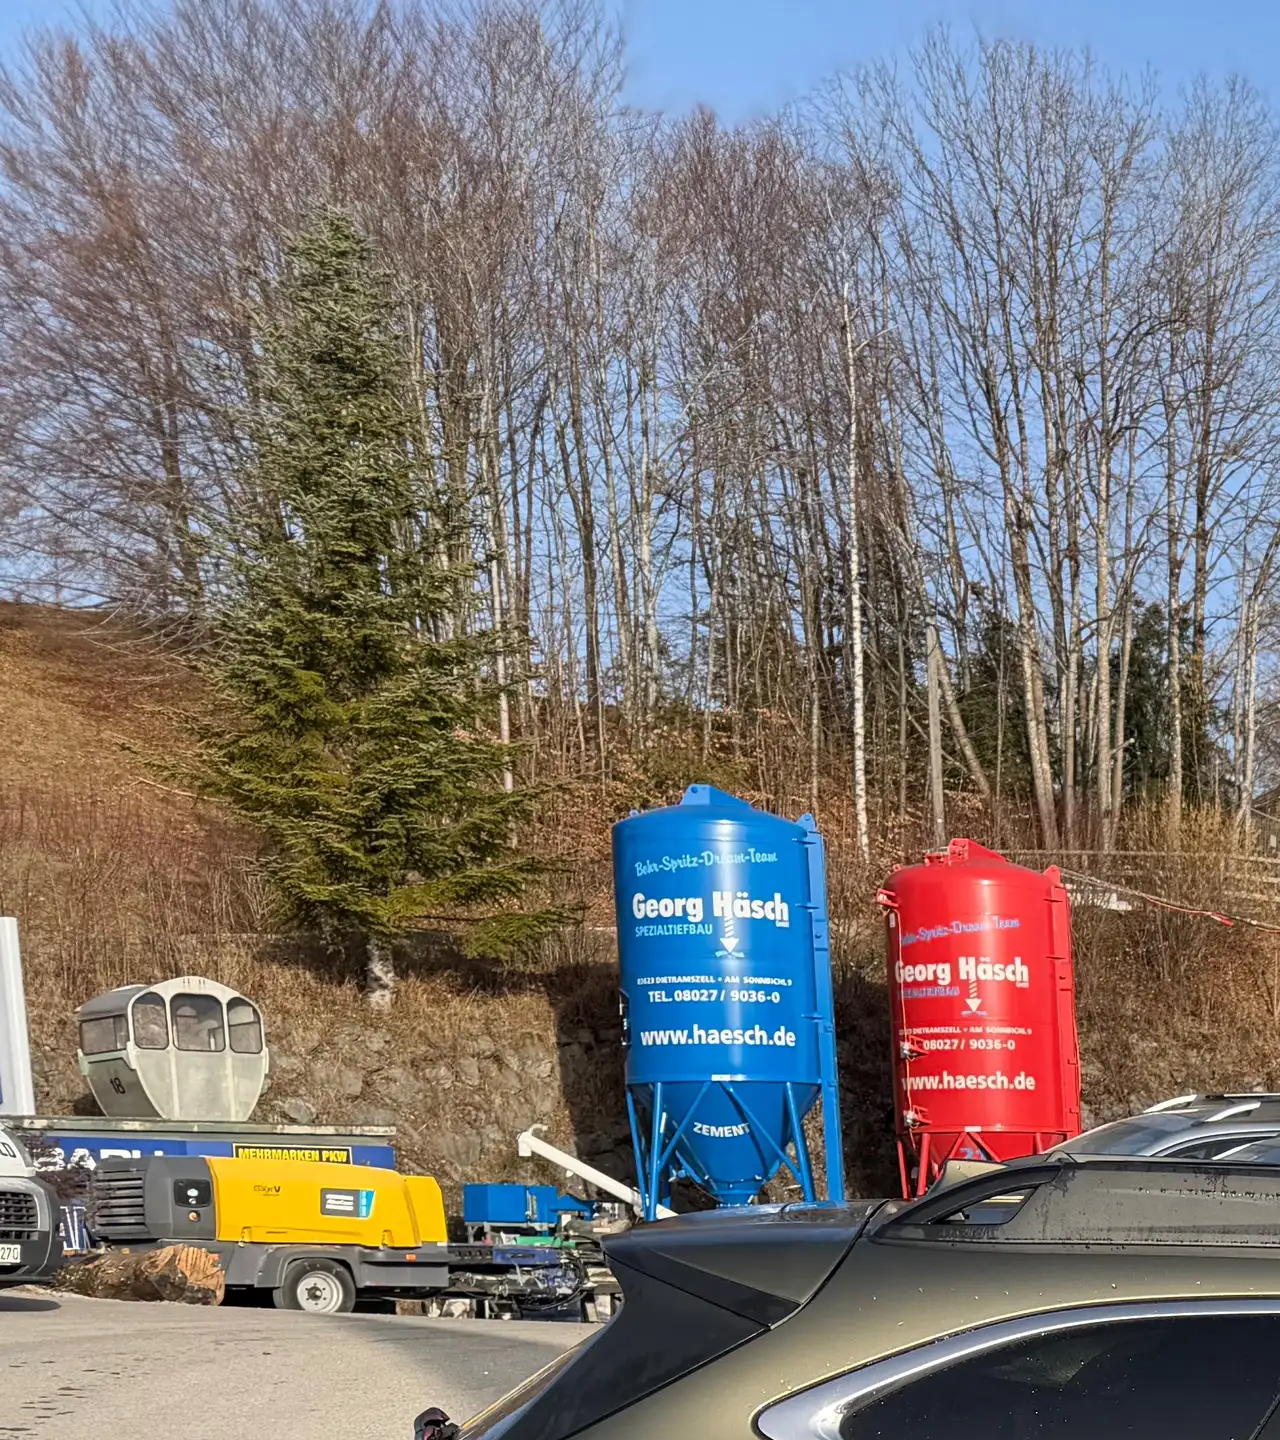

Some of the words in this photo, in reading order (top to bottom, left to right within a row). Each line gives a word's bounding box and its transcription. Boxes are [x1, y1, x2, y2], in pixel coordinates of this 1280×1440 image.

[632, 892, 704, 923] Georg
[712, 890, 790, 922] Häsch
[635, 923, 713, 938] SPEZIALTIEFBAU
[895, 959, 952, 987] Georg
[958, 956, 1030, 983] Häsch
[648, 991, 673, 1003] TEL.
[674, 990, 718, 1002] 08027
[730, 990, 781, 1003] 9036-0
[640, 1023, 797, 1047] www.haesch.de
[969, 1038, 1016, 1051] 9036-0
[109, 1077, 126, 1095] 18
[902, 1070, 1036, 1091] www.haesch.de
[693, 1121, 750, 1138] ZEMENT
[238, 1148, 320, 1162] MEHRMARKEN
[321, 1150, 348, 1162] PKW
